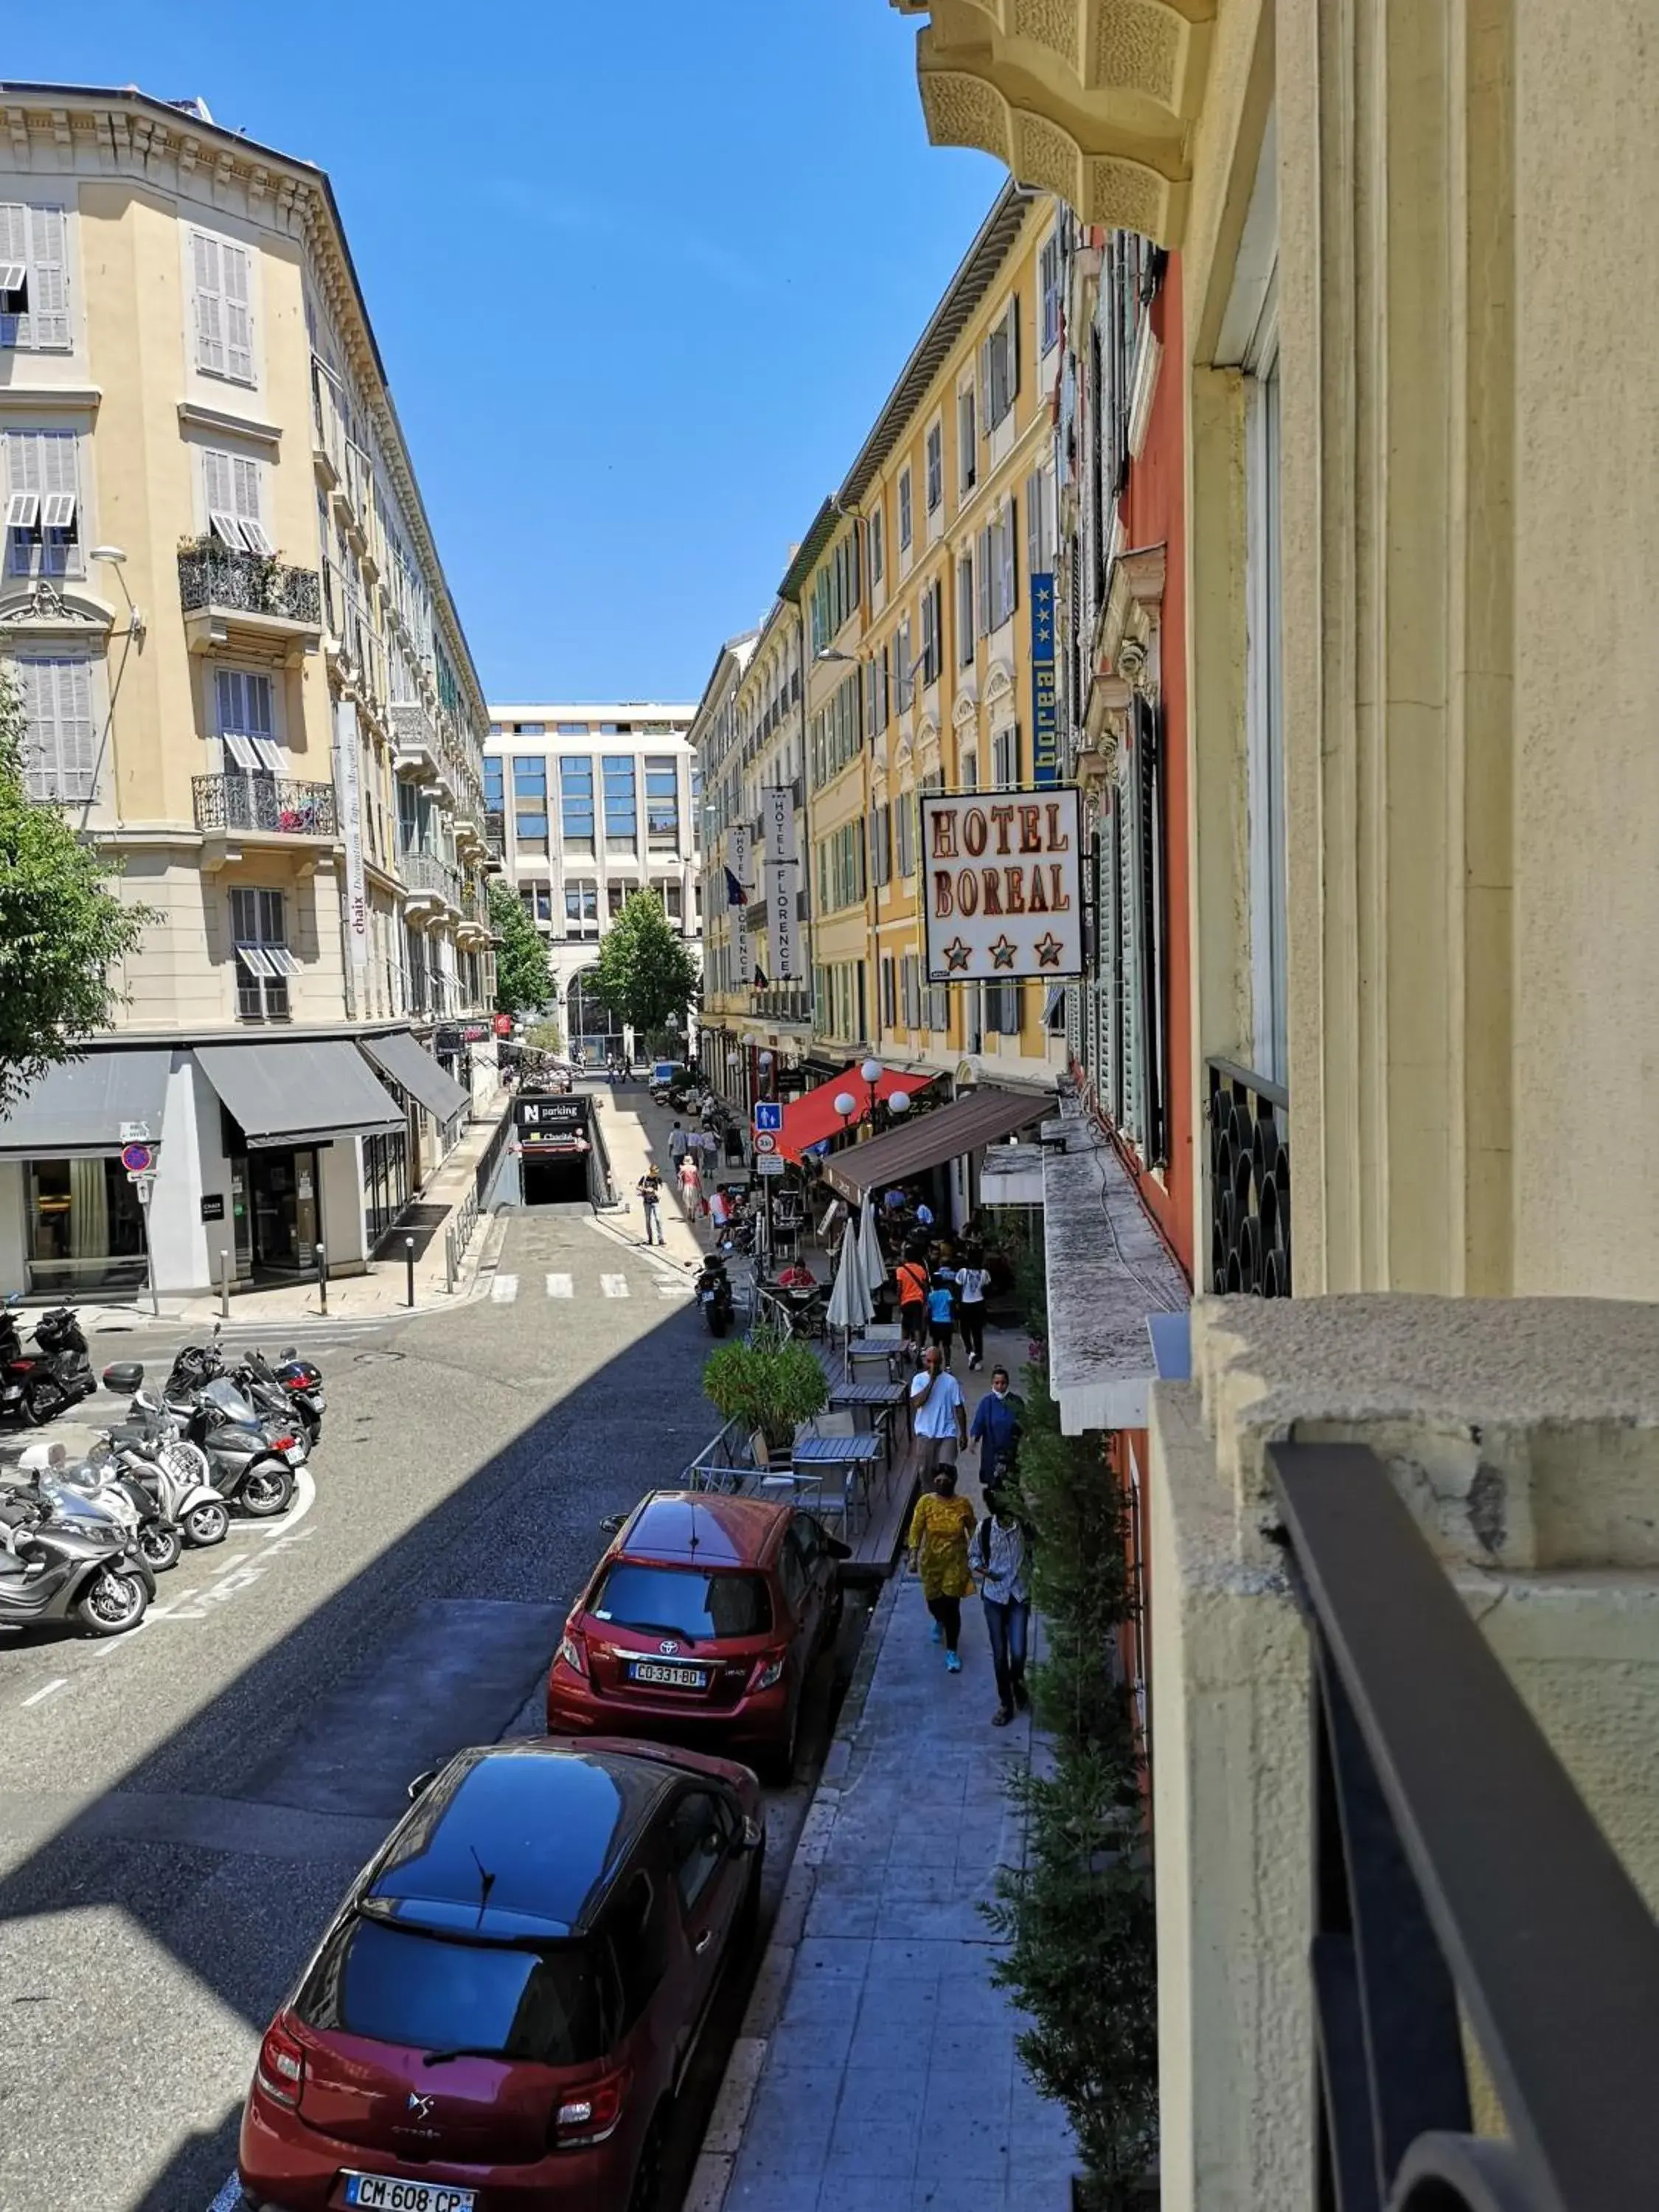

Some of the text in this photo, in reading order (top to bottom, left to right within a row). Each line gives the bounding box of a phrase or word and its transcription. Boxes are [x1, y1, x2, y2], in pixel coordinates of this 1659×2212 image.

[1033, 660, 1055, 767] boreal
[931, 803, 1068, 858] HOTEL
[775, 801, 789, 971] HOTEL FLORENCE
[934, 864, 1070, 917] BOREAL
[352, 897, 365, 934] chaix
[738, 904, 747, 975] LORENCE
[542, 1106, 577, 1117] parking
